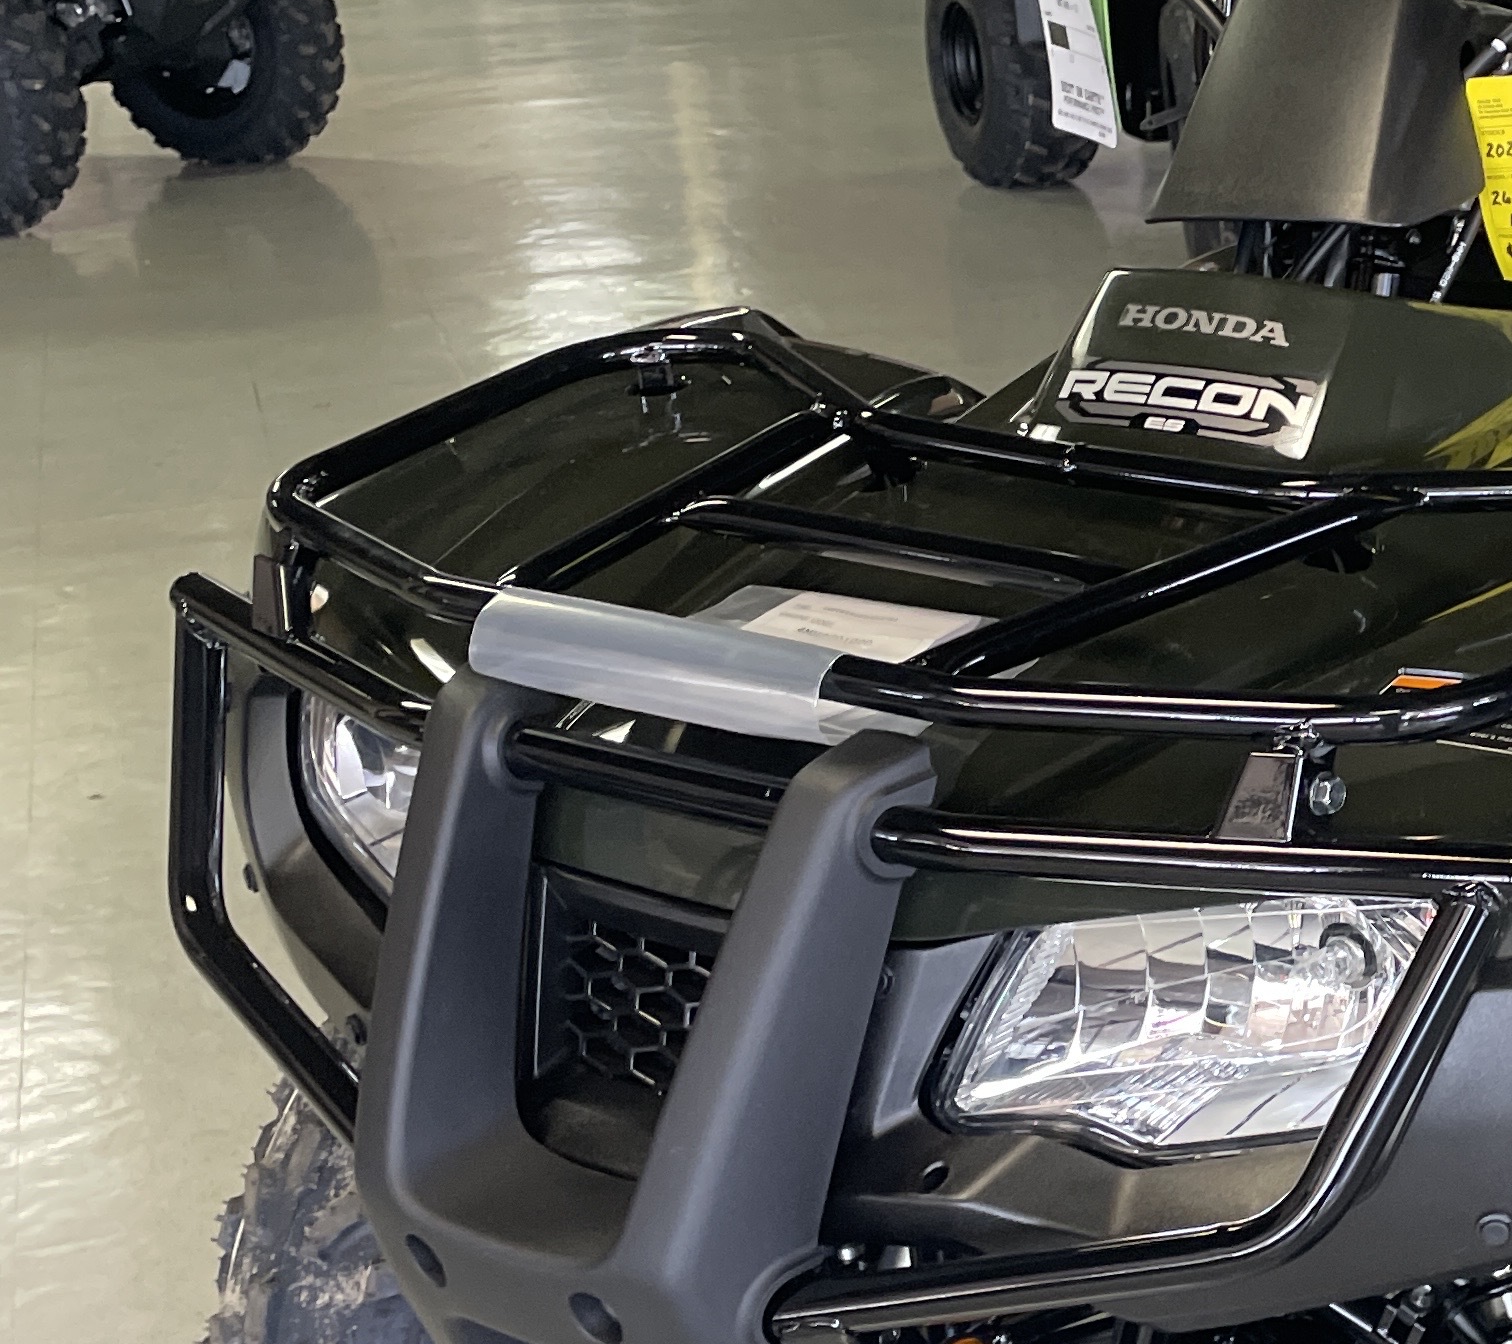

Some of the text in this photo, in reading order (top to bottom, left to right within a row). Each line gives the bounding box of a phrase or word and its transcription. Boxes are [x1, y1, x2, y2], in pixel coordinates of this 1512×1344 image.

[1491, 190, 1511, 205] 26
[1118, 303, 1289, 348] HONDA
[1058, 369, 1314, 431] RECON
